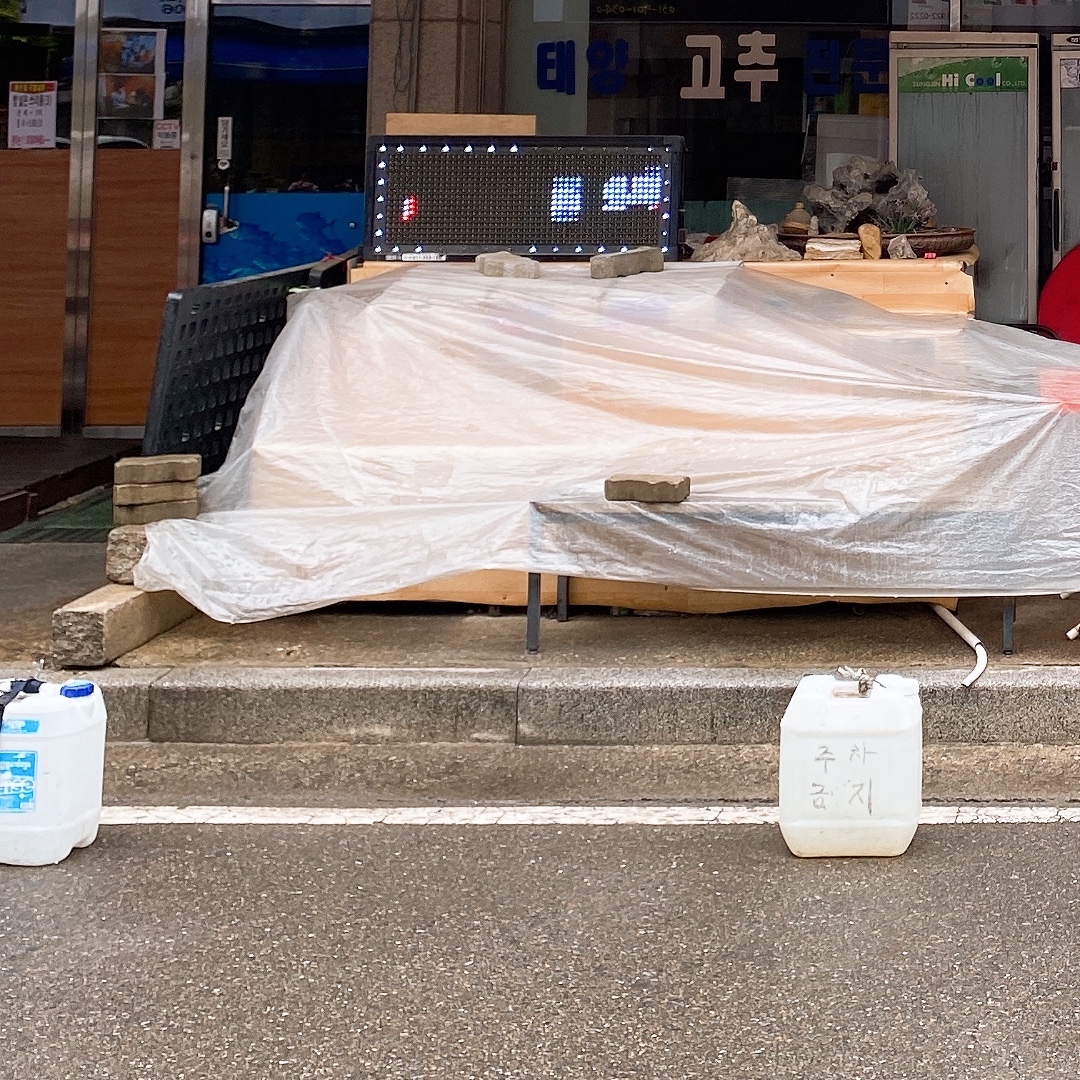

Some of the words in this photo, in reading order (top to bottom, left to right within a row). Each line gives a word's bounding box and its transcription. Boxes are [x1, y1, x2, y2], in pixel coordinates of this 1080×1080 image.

[679, 29, 779, 103] 고추
[941, 72, 959, 88] Hi
[965, 72, 1002, 88] Cool
